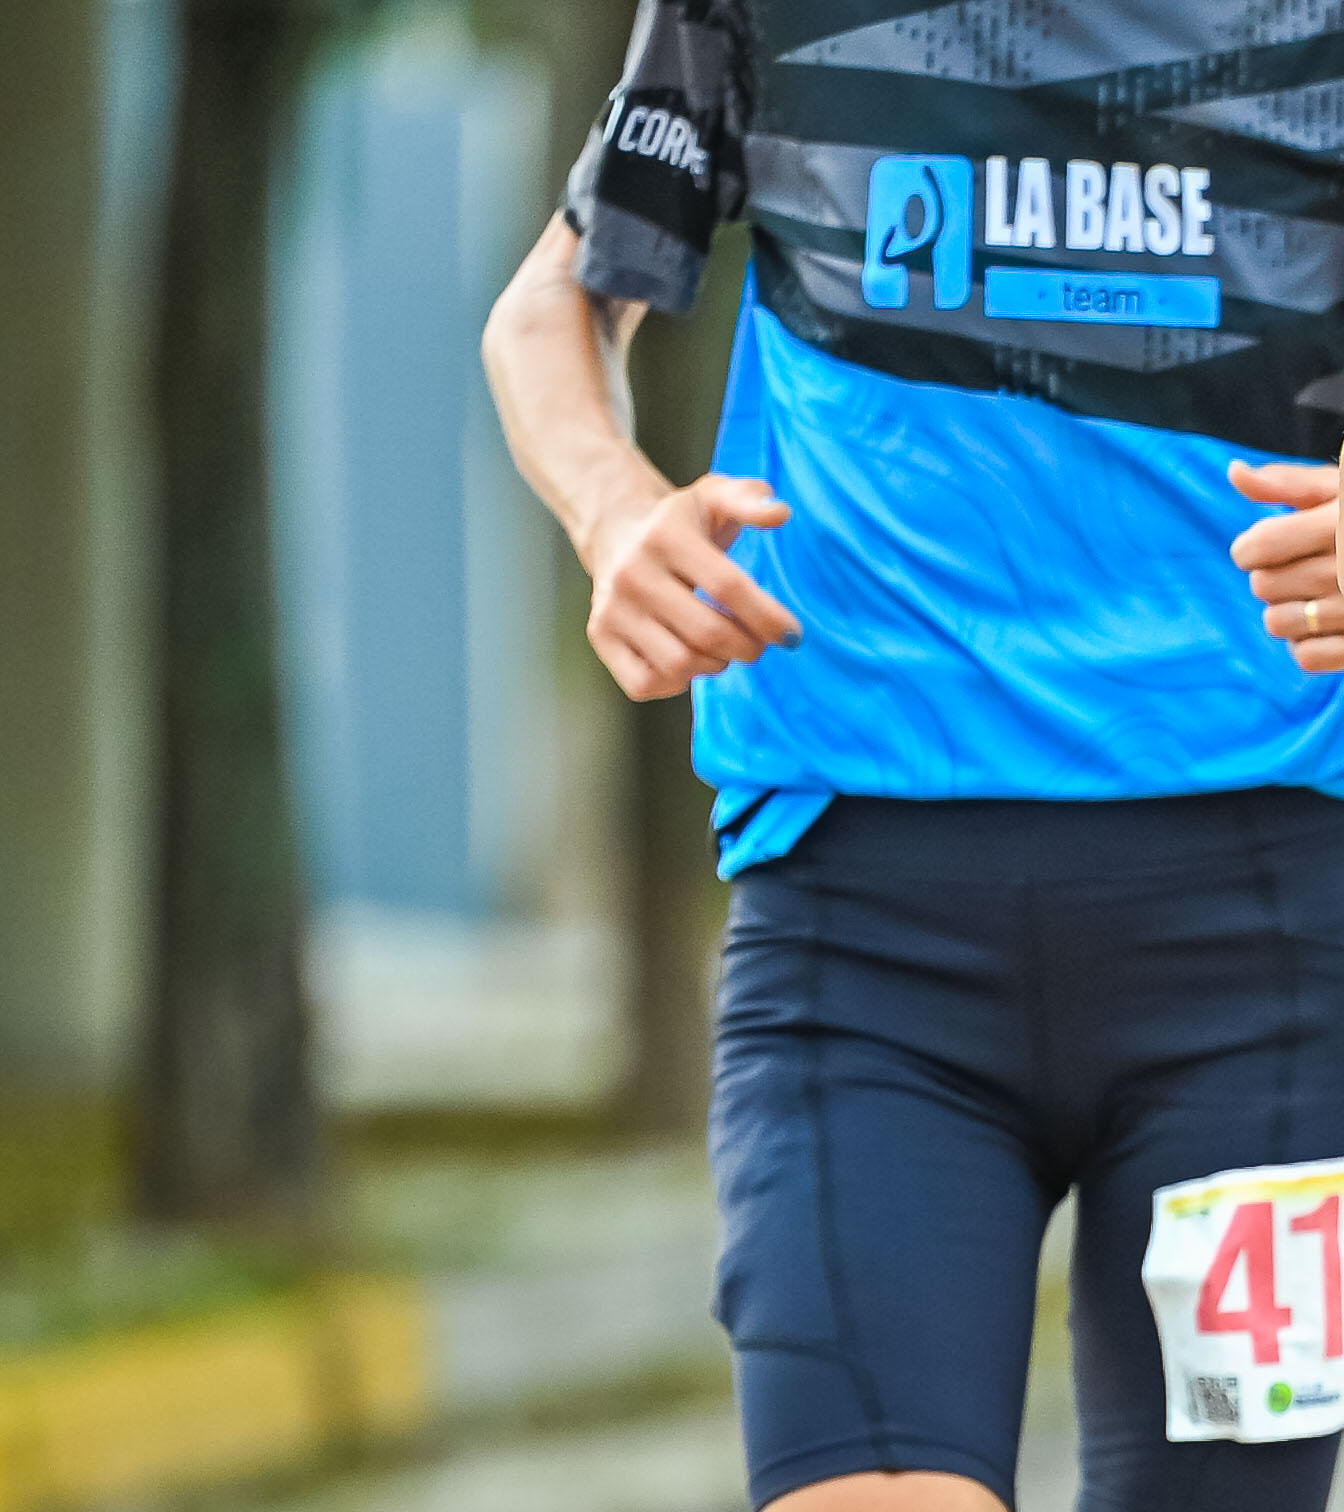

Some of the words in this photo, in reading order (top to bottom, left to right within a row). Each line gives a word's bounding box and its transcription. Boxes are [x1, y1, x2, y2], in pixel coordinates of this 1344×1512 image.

[985, 155, 1057, 249] LA
[1065, 158, 1216, 257] BASE
[1063, 282, 1141, 314] team
